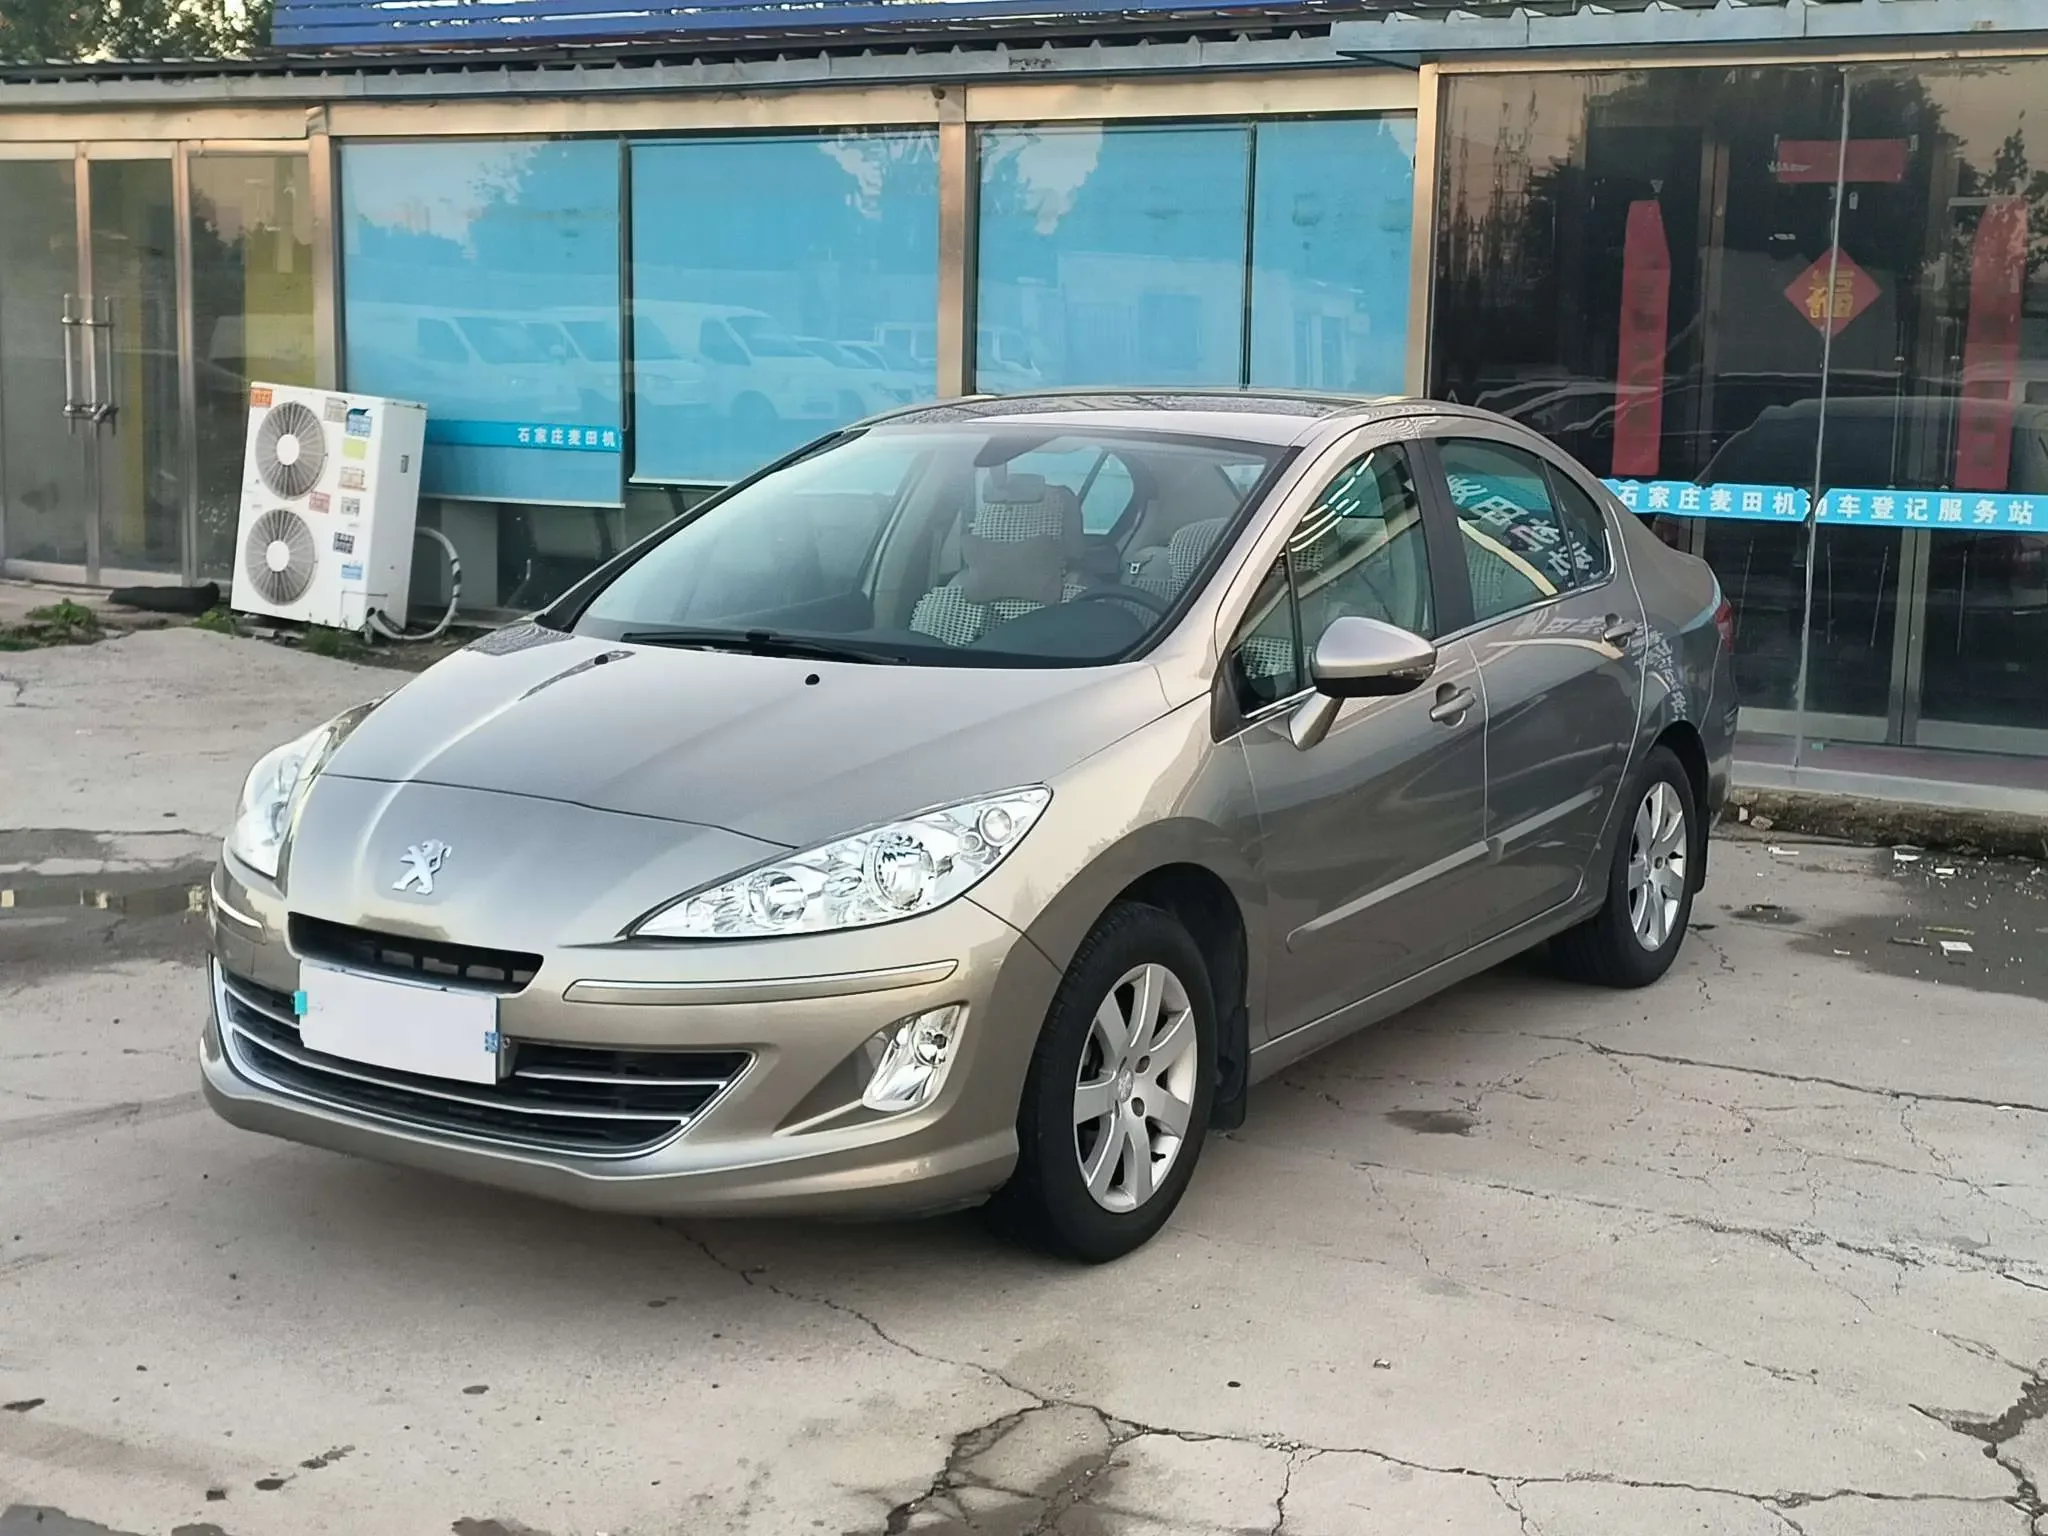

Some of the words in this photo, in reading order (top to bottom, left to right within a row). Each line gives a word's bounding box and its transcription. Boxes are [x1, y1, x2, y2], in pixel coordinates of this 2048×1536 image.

[1805, 269, 1856, 318] 福
[517, 427, 622, 447] 石家庄麦田机
